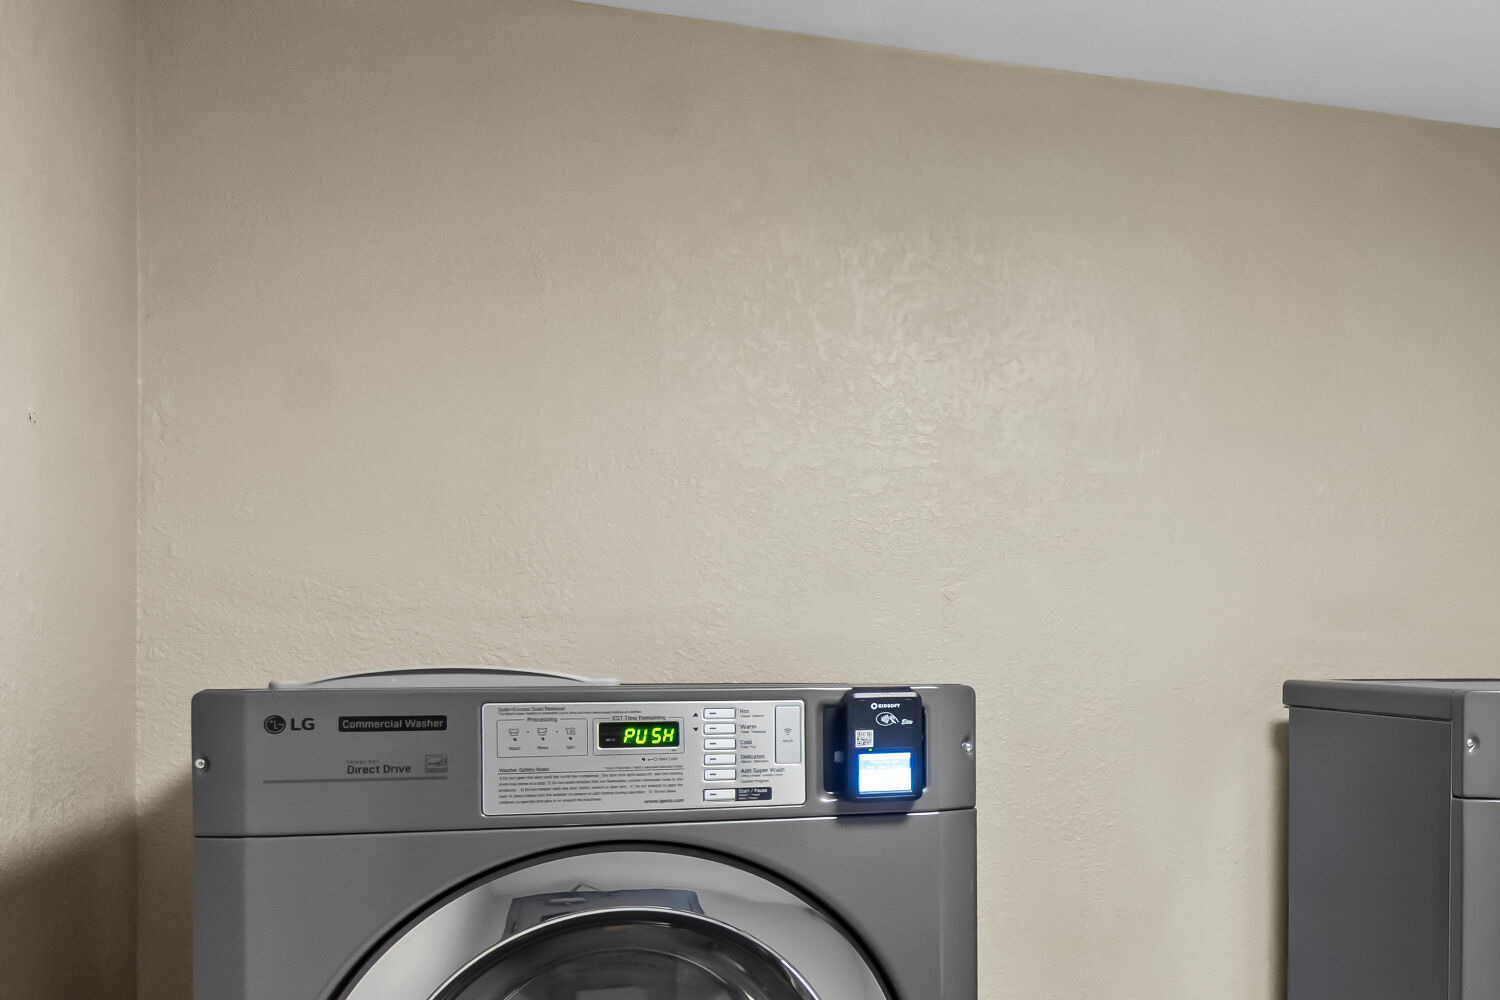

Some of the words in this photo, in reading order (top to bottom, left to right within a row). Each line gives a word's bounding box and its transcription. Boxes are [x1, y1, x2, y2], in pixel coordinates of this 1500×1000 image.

[290, 717, 316, 731] LG
[342, 719, 403, 729] Commercial
[404, 718, 444, 729] Washer
[623, 727, 675, 745] PUSH
[347, 765, 381, 775] Direct
[383, 764, 412, 774] Drive
